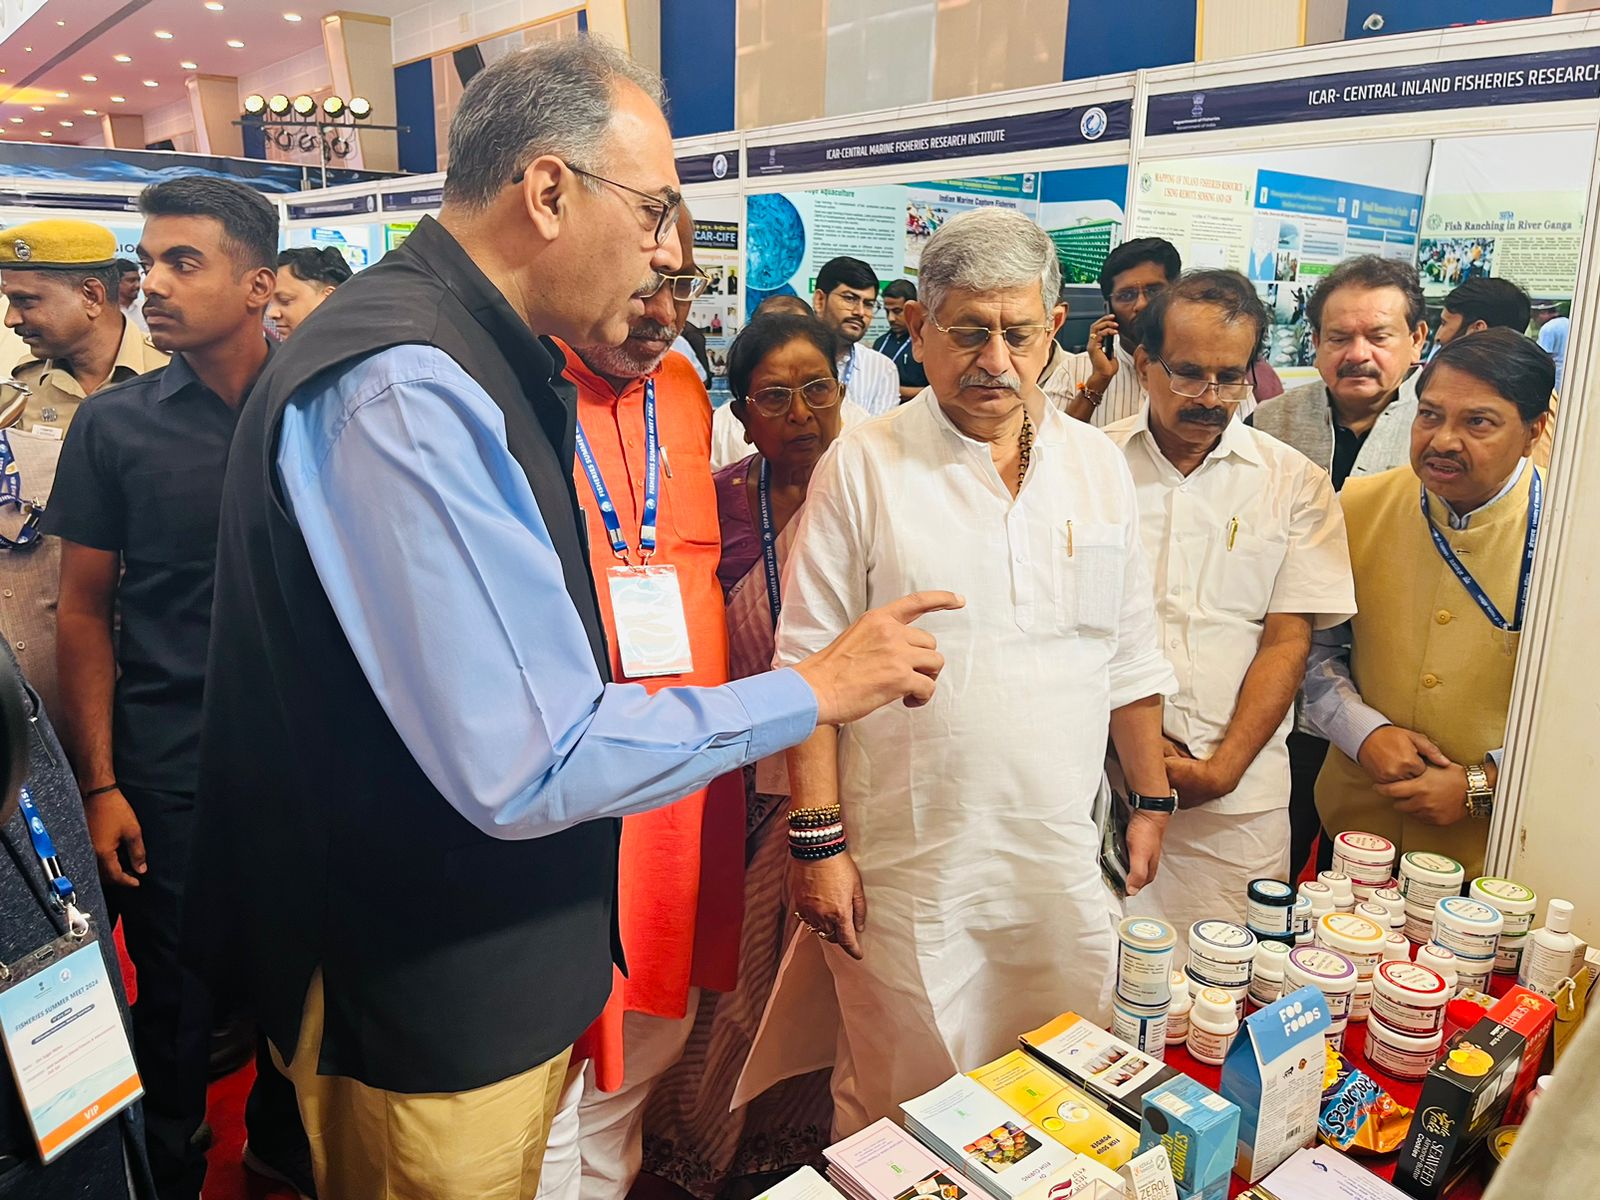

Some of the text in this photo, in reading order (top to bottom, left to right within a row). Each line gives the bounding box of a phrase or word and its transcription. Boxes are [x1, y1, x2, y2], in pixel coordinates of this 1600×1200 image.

[1308, 89, 1341, 106] ICAR-
[1343, 81, 1398, 103] CENTRAL
[1401, 76, 1450, 96] INLAND
[1454, 70, 1524, 92] FISHERIES
[826, 129, 1006, 160] ICAR-CENTRAL MARINE FISHERIES RESEARCH INSTITUTE
[939, 194, 1016, 208] Indian Marine Capture Fisheries
[694, 231, 736, 242] CAR-CIFE
[1444, 219, 1572, 232] Fish Ranching in River Ganga
[587, 464, 605, 497] FISHERIES
[761, 490, 769, 529] DEPARTMENT
[771, 577, 779, 602] SUMMER
[15, 979, 99, 1031] FISHERIES SUMMER MEET 2024
[1279, 1001, 1302, 1023] FOO
[1284, 1007, 1321, 1037] FOODS
[83, 1105, 99, 1121] VIP
[1091, 1134, 1112, 1149] POWDER
[1096, 1138, 1120, 1155] FISH SOUP
[1172, 1131, 1188, 1181] COOKIES
[1420, 1140, 1445, 1187] SEAWEED
